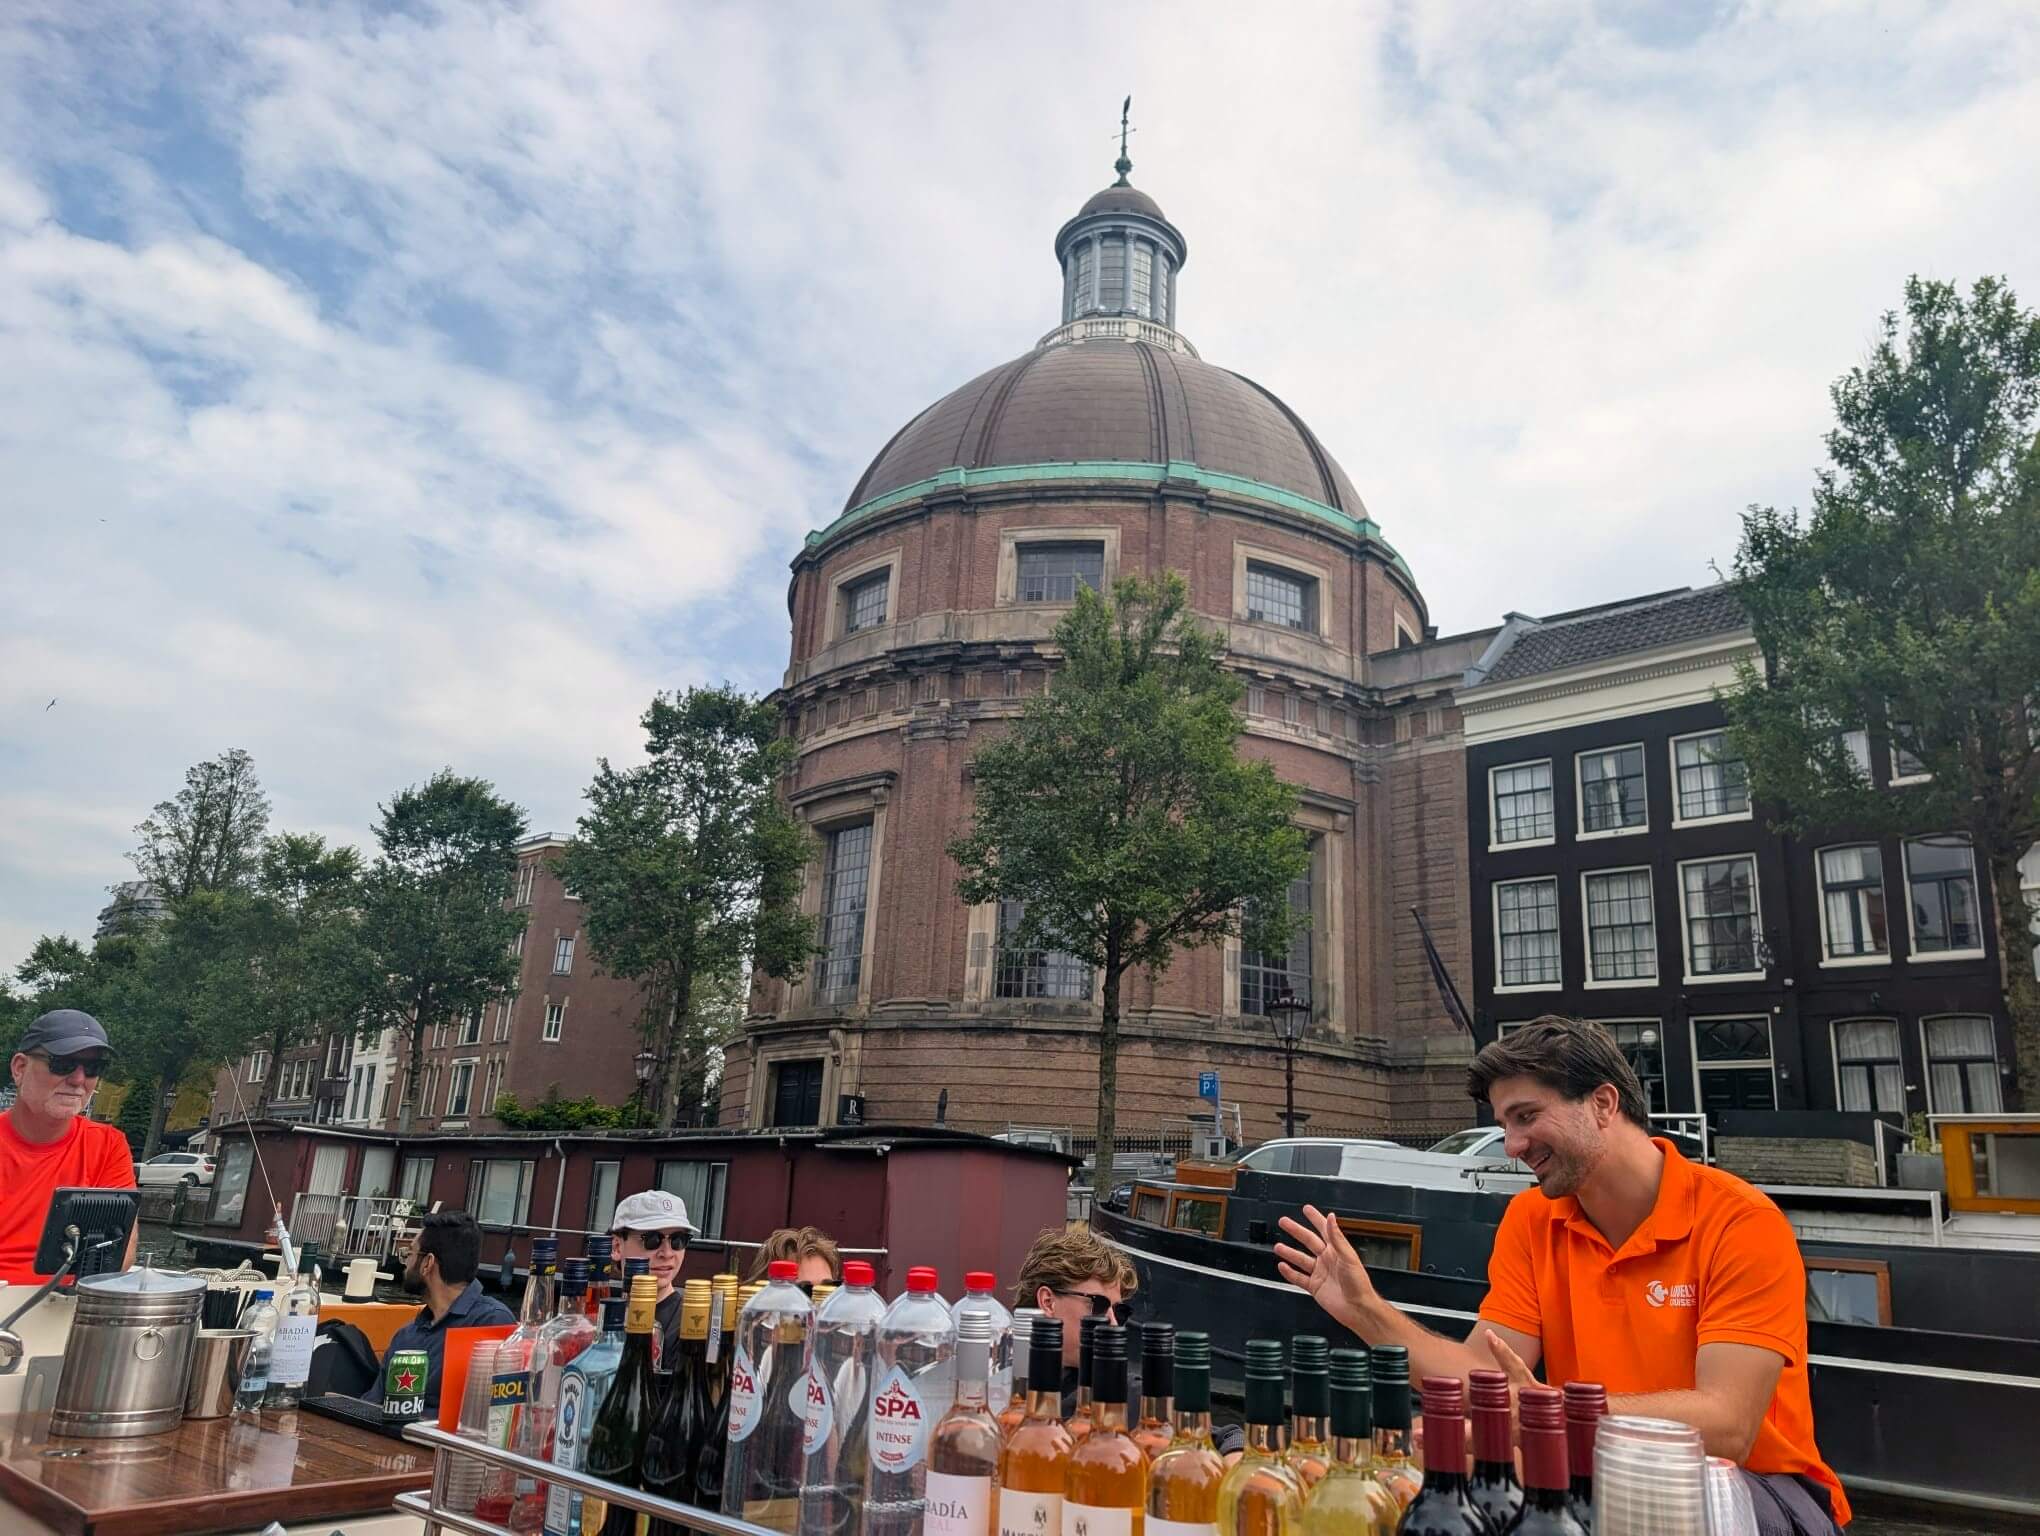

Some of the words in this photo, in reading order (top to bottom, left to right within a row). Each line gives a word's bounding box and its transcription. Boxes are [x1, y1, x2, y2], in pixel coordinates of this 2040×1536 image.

[1203, 1081, 1210, 1094] P
[849, 1099, 858, 1115] R
[383, 1396, 425, 1415] inek
[874, 1396, 922, 1420] SPA
[876, 1431, 913, 1445] INTENSE
